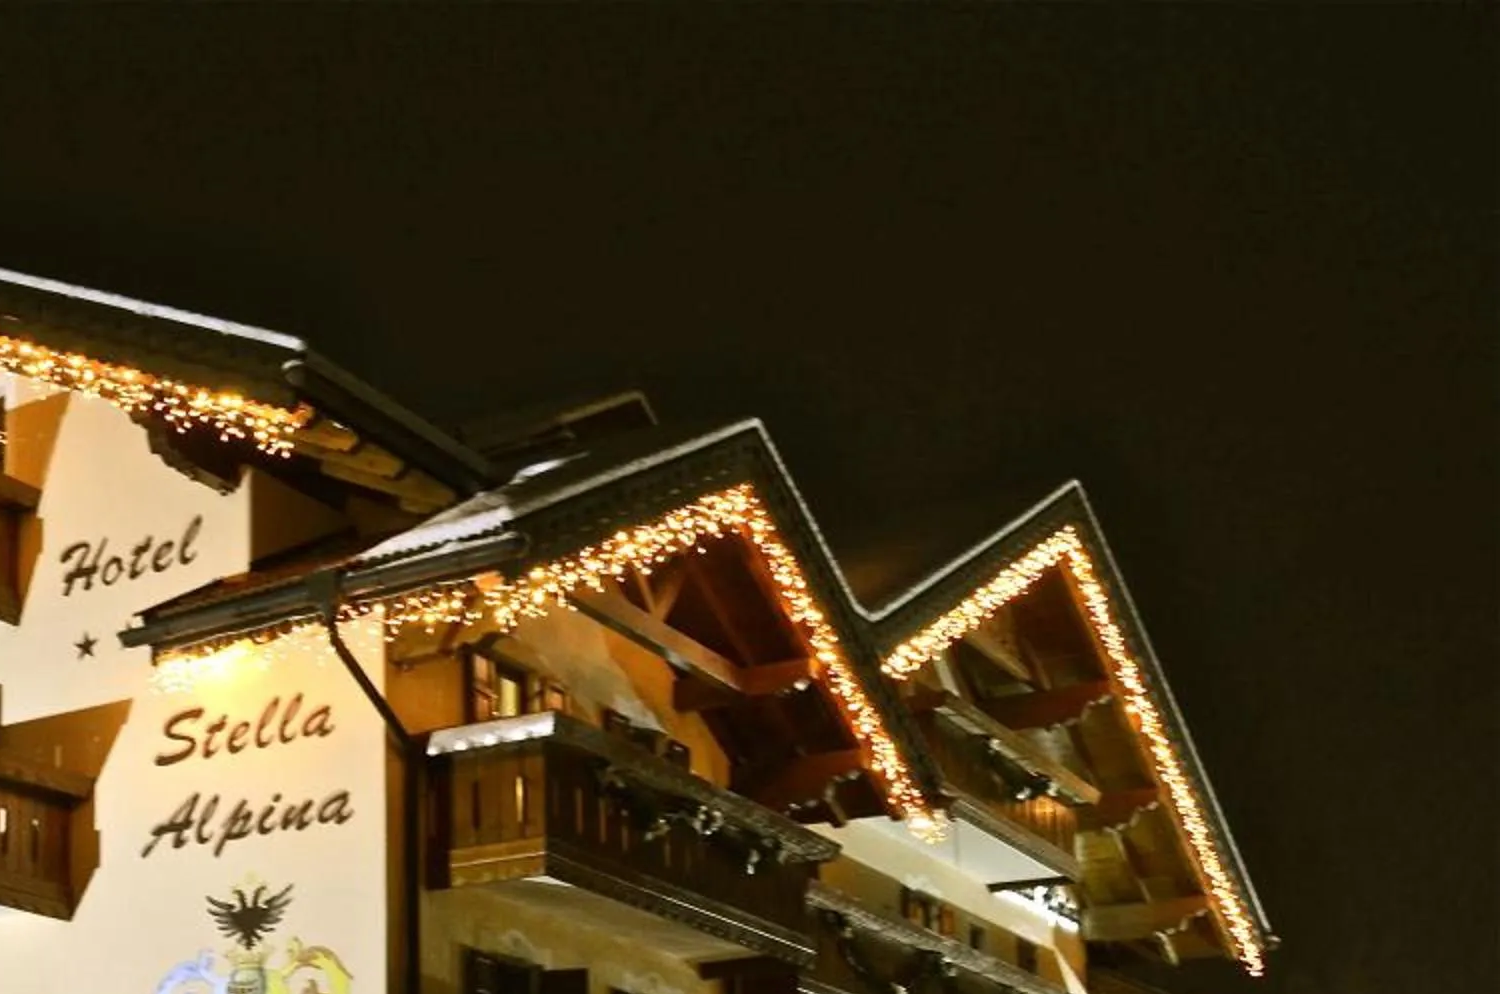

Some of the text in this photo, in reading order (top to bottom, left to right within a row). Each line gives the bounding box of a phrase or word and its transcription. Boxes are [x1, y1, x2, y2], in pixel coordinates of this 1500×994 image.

[60, 514, 203, 596] Hotel
[154, 692, 336, 767] Stella
[141, 789, 354, 859] Alpina
